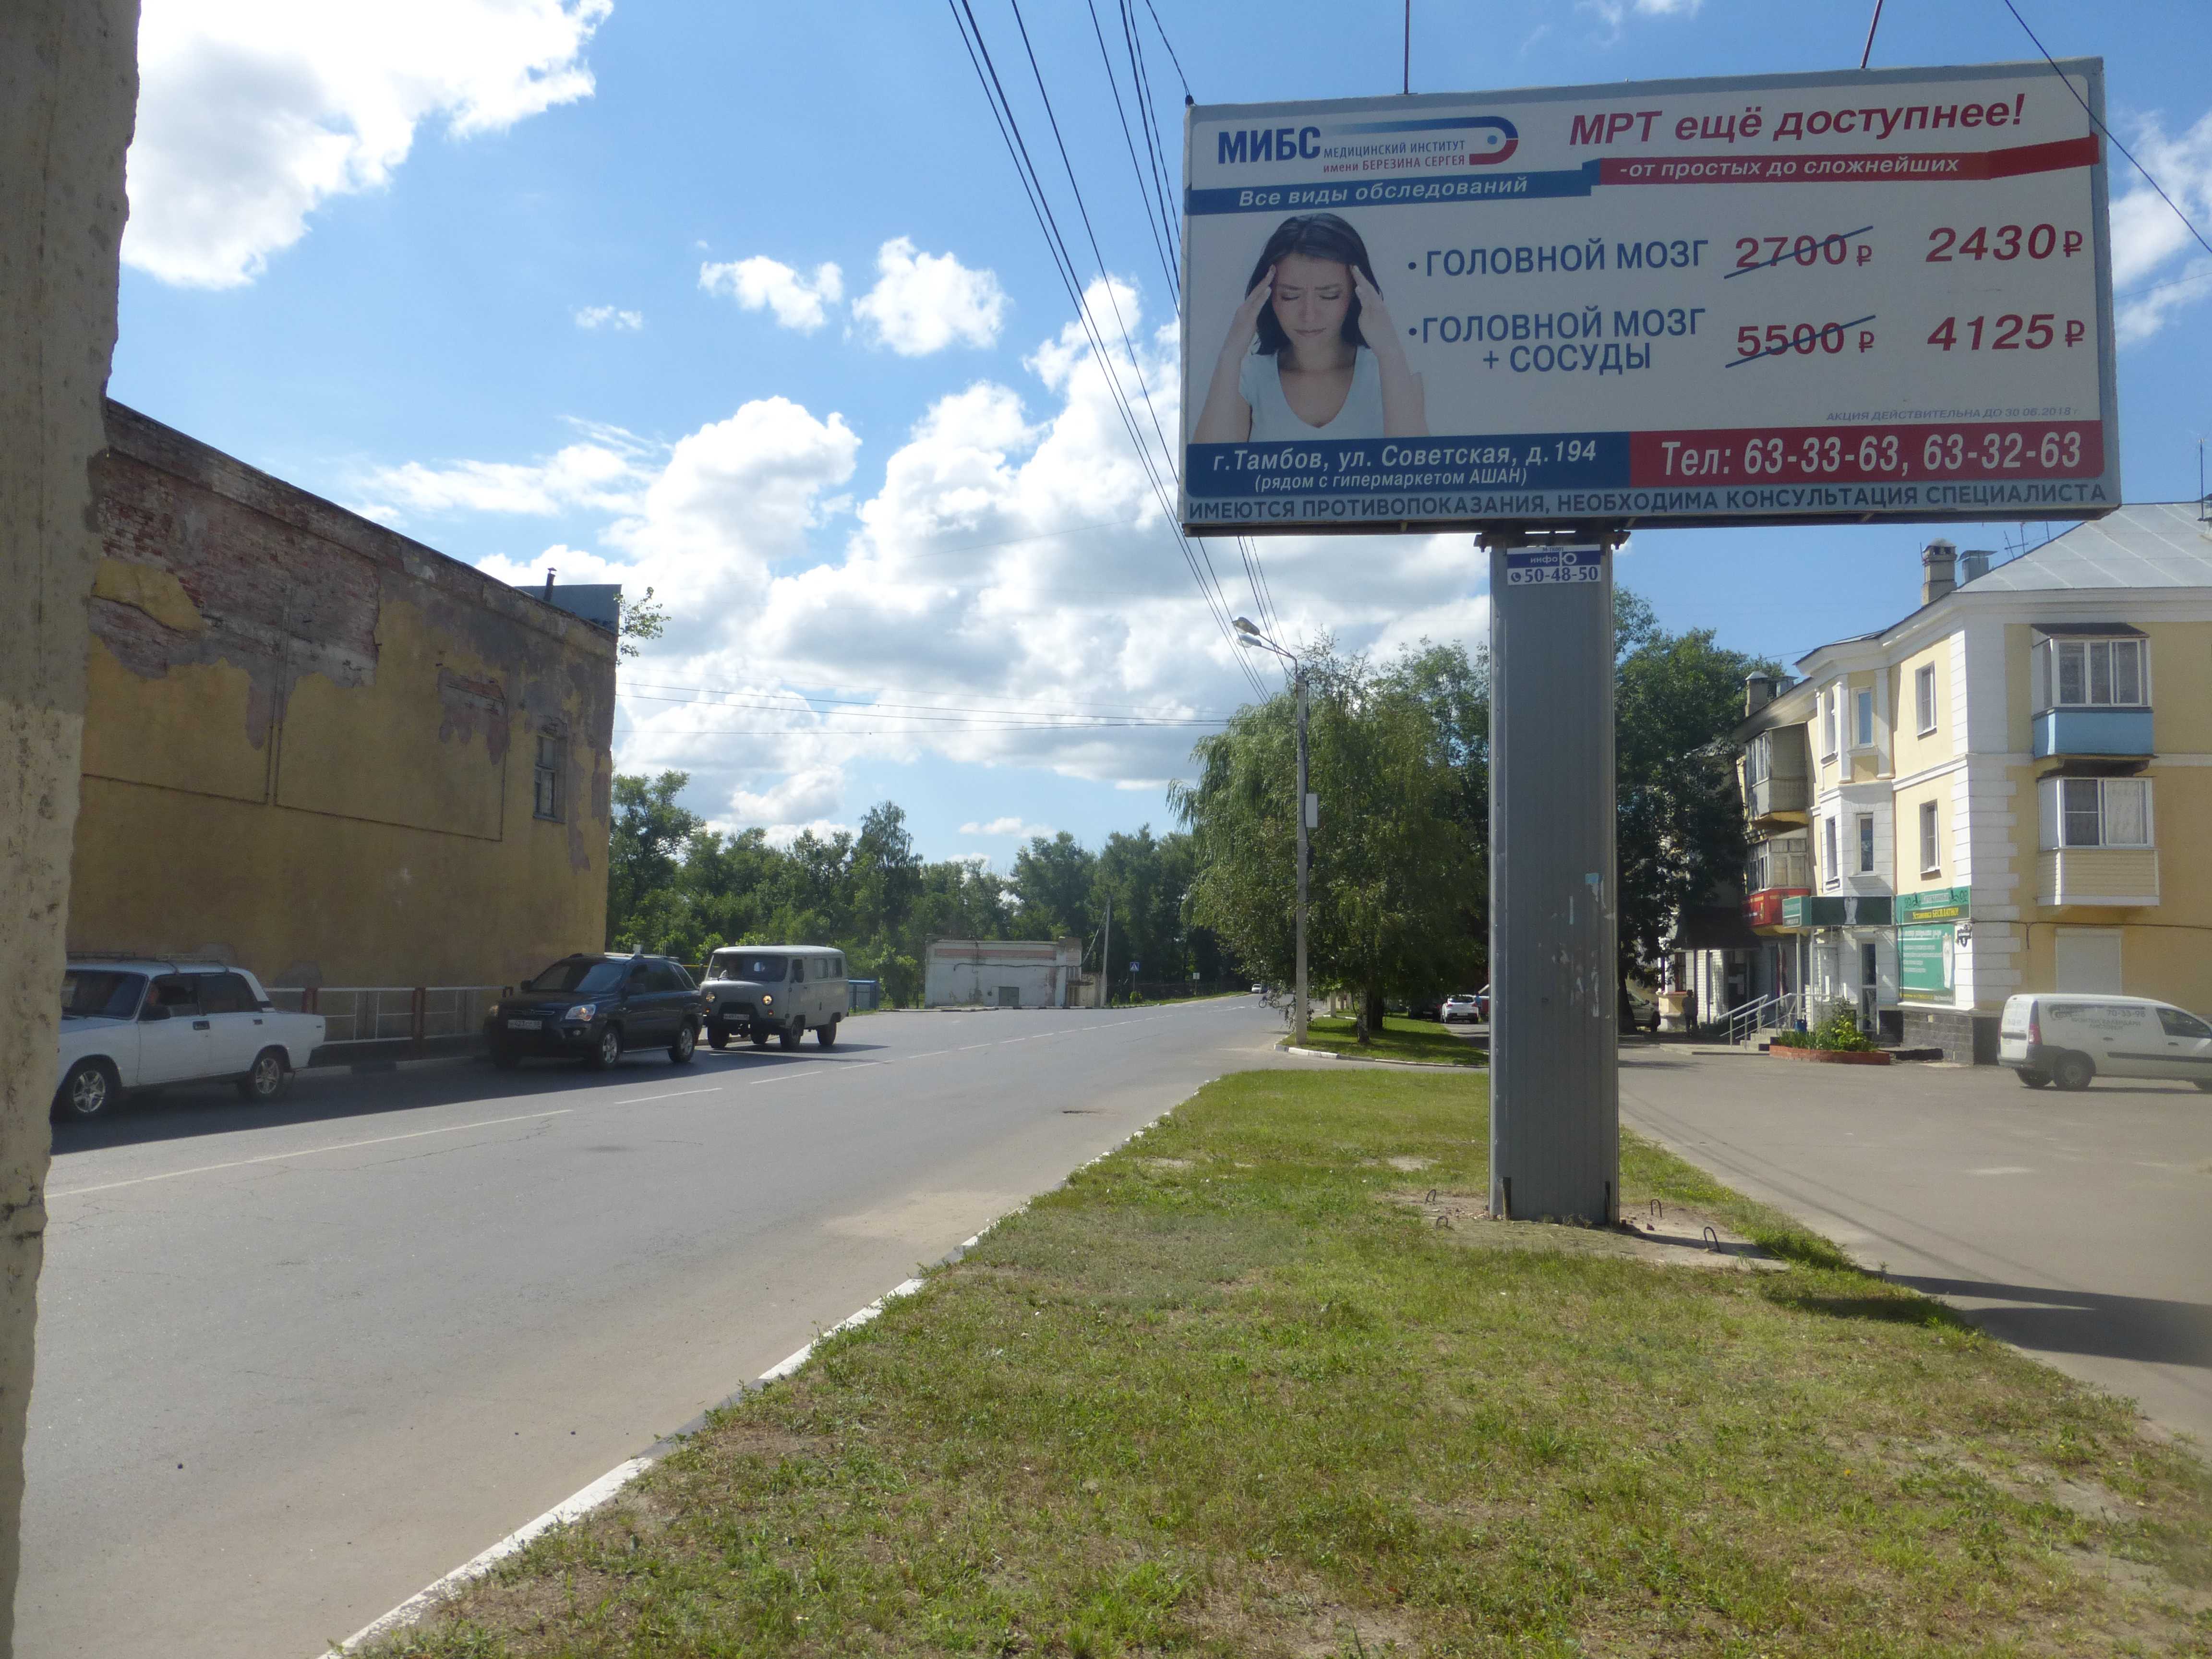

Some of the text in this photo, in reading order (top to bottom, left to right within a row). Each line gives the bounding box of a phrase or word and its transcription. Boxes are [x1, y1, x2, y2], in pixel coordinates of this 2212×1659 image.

[1569, 94, 2026, 145] МРТ ещё доступнее!
[1218, 127, 1321, 164] МИБС
[1323, 140, 1465, 159] МЕДИЦИНСКИЙ ИНСТИТУТ
[1323, 155, 1465, 172] имени БЕРЕЗИНА СЕРГЕЯ
[1661, 163, 1762, 179] простых
[1767, 160, 1797, 177] до
[1803, 156, 1960, 175] сложнейших
[1239, 177, 1527, 207] Все виды обследований
[1427, 238, 1708, 276] ГОЛОВНОЙ МОЗГ
[1422, 305, 1706, 343] ГОЛОВНОЙ МОЗГ
[1510, 343, 1650, 375] СОСУДЫ
[1827, 412, 1869, 421] АКЦИЯ
[1872, 409, 1981, 421] ДЕЙСТВИТЕЛЬНА
[1983, 409, 2002, 419] ДО
[1339, 451, 1371, 472] ул.
[1382, 444, 1517, 469] Советская,
[1661, 431, 2081, 477] Тел: 63-33-63, 63-32-63
[1255, 467, 1527, 492] (рядом с гипермаркетом АШАН)
[1190, 483, 2106, 519] ИМЕЮТСЯ ПРОТИВОПОКАЗАНИЯ, НЕОБХОДИМА КОНСУЛЬТАЦИЯ СПЕЦИАЛИСТА
[1525, 566, 1598, 583] 50-48-50
